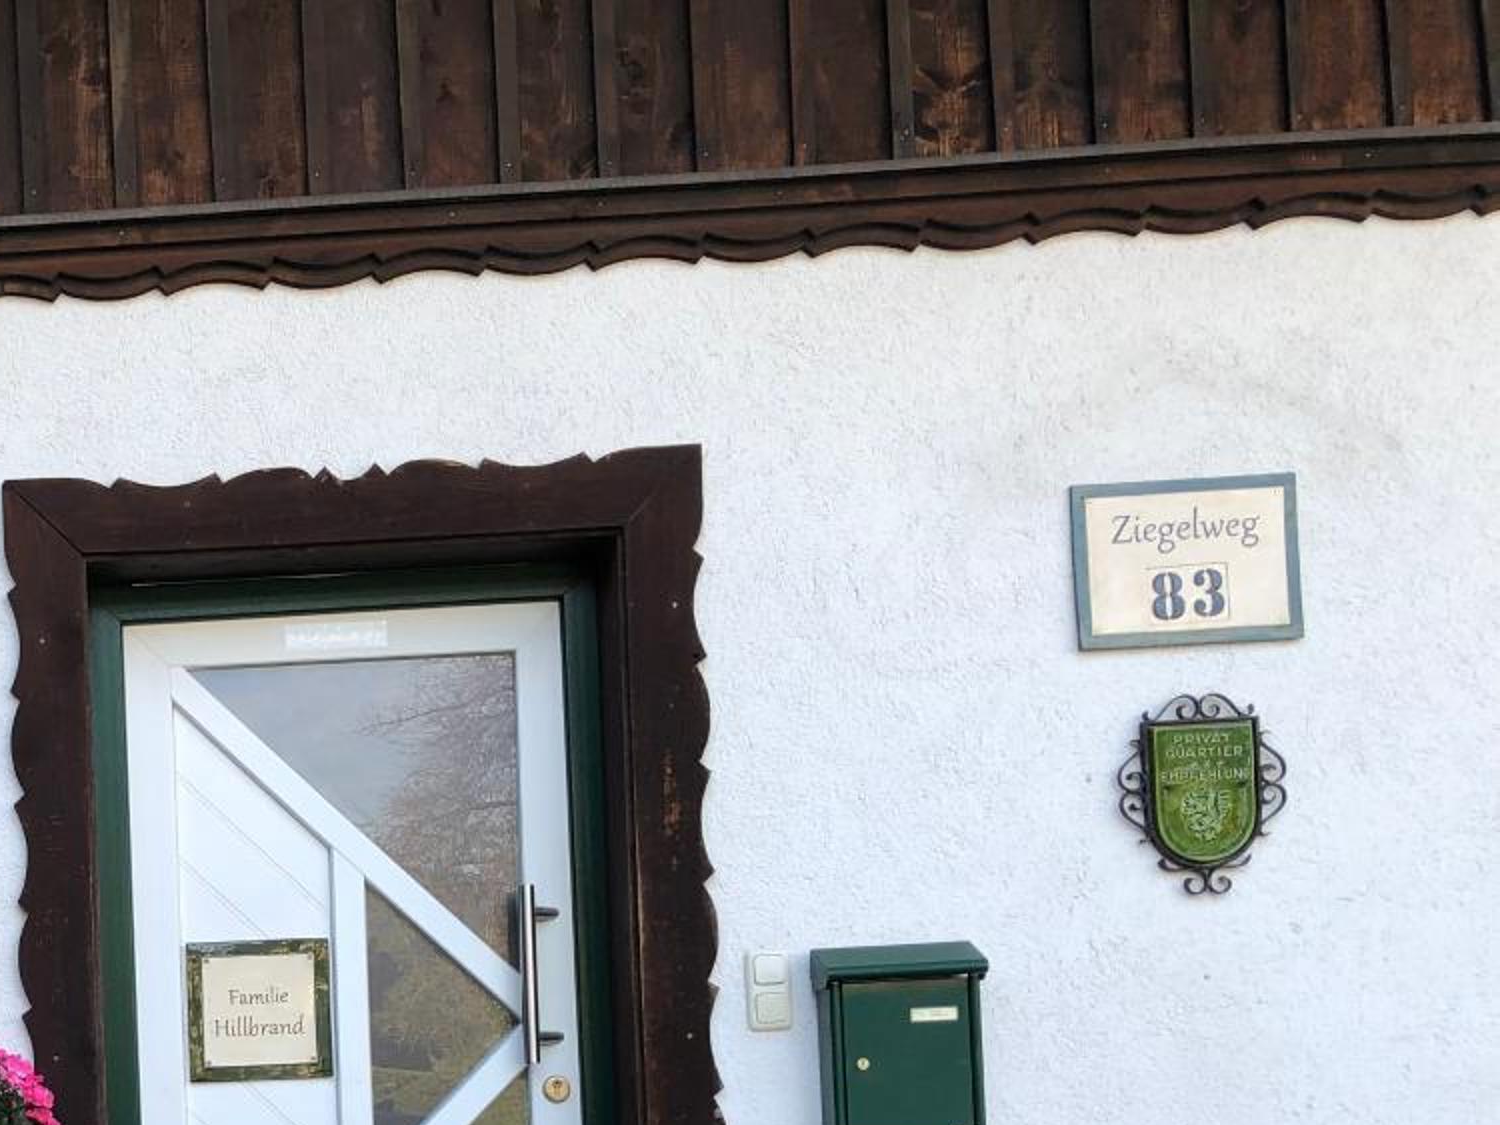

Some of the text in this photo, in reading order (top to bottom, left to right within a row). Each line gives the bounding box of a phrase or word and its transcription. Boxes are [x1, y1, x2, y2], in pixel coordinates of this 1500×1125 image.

[1111, 506, 1261, 554] Ziegelweg
[1152, 568, 1225, 620] 83
[1173, 733, 1229, 745] PRIVAT
[1165, 745, 1243, 759] QUARTIER
[228, 986, 289, 1005] Familie
[214, 1015, 306, 1037] Hillbrand
